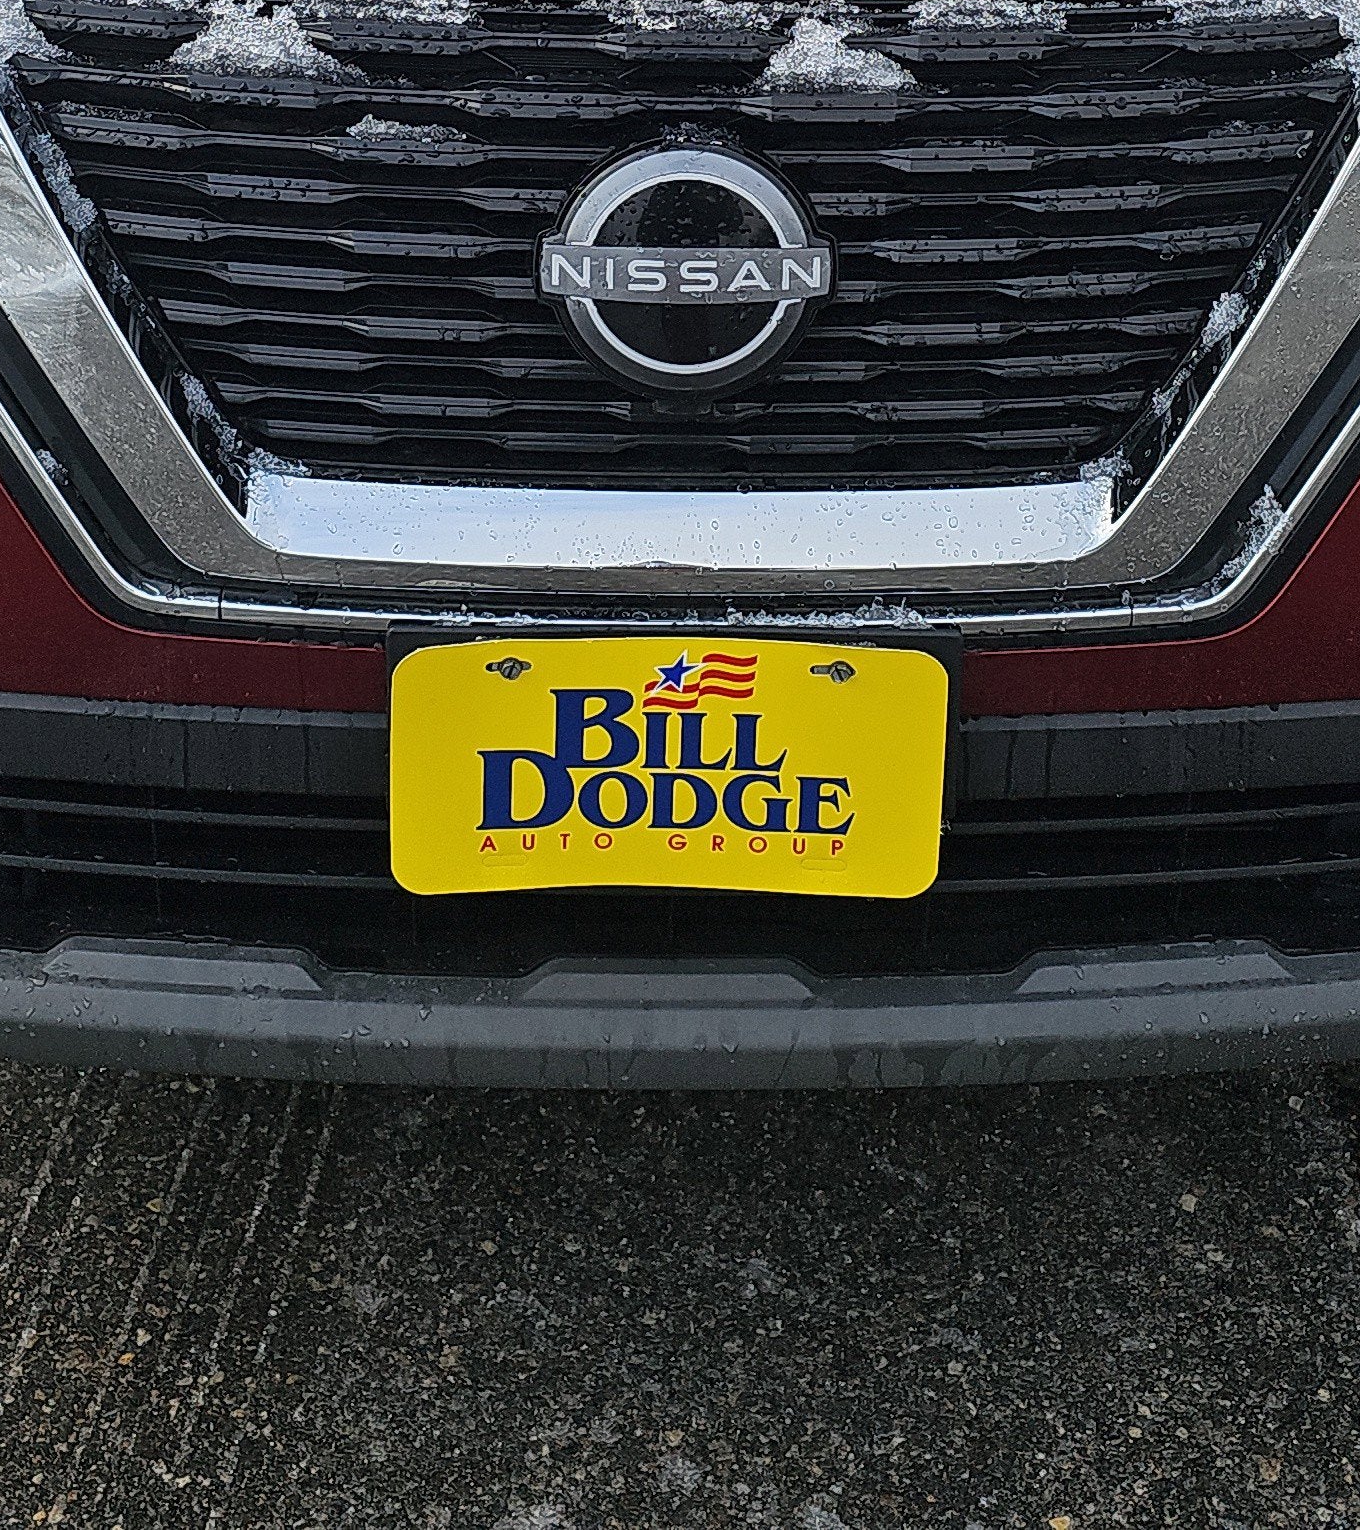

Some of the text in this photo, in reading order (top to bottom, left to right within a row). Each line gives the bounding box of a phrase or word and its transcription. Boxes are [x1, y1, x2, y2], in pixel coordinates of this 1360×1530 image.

[550, 253, 821, 293] NISSAN
[550, 688, 788, 771] BILL
[476, 749, 856, 834] DODGE
[479, 833, 844, 856] AUTO GROUP
